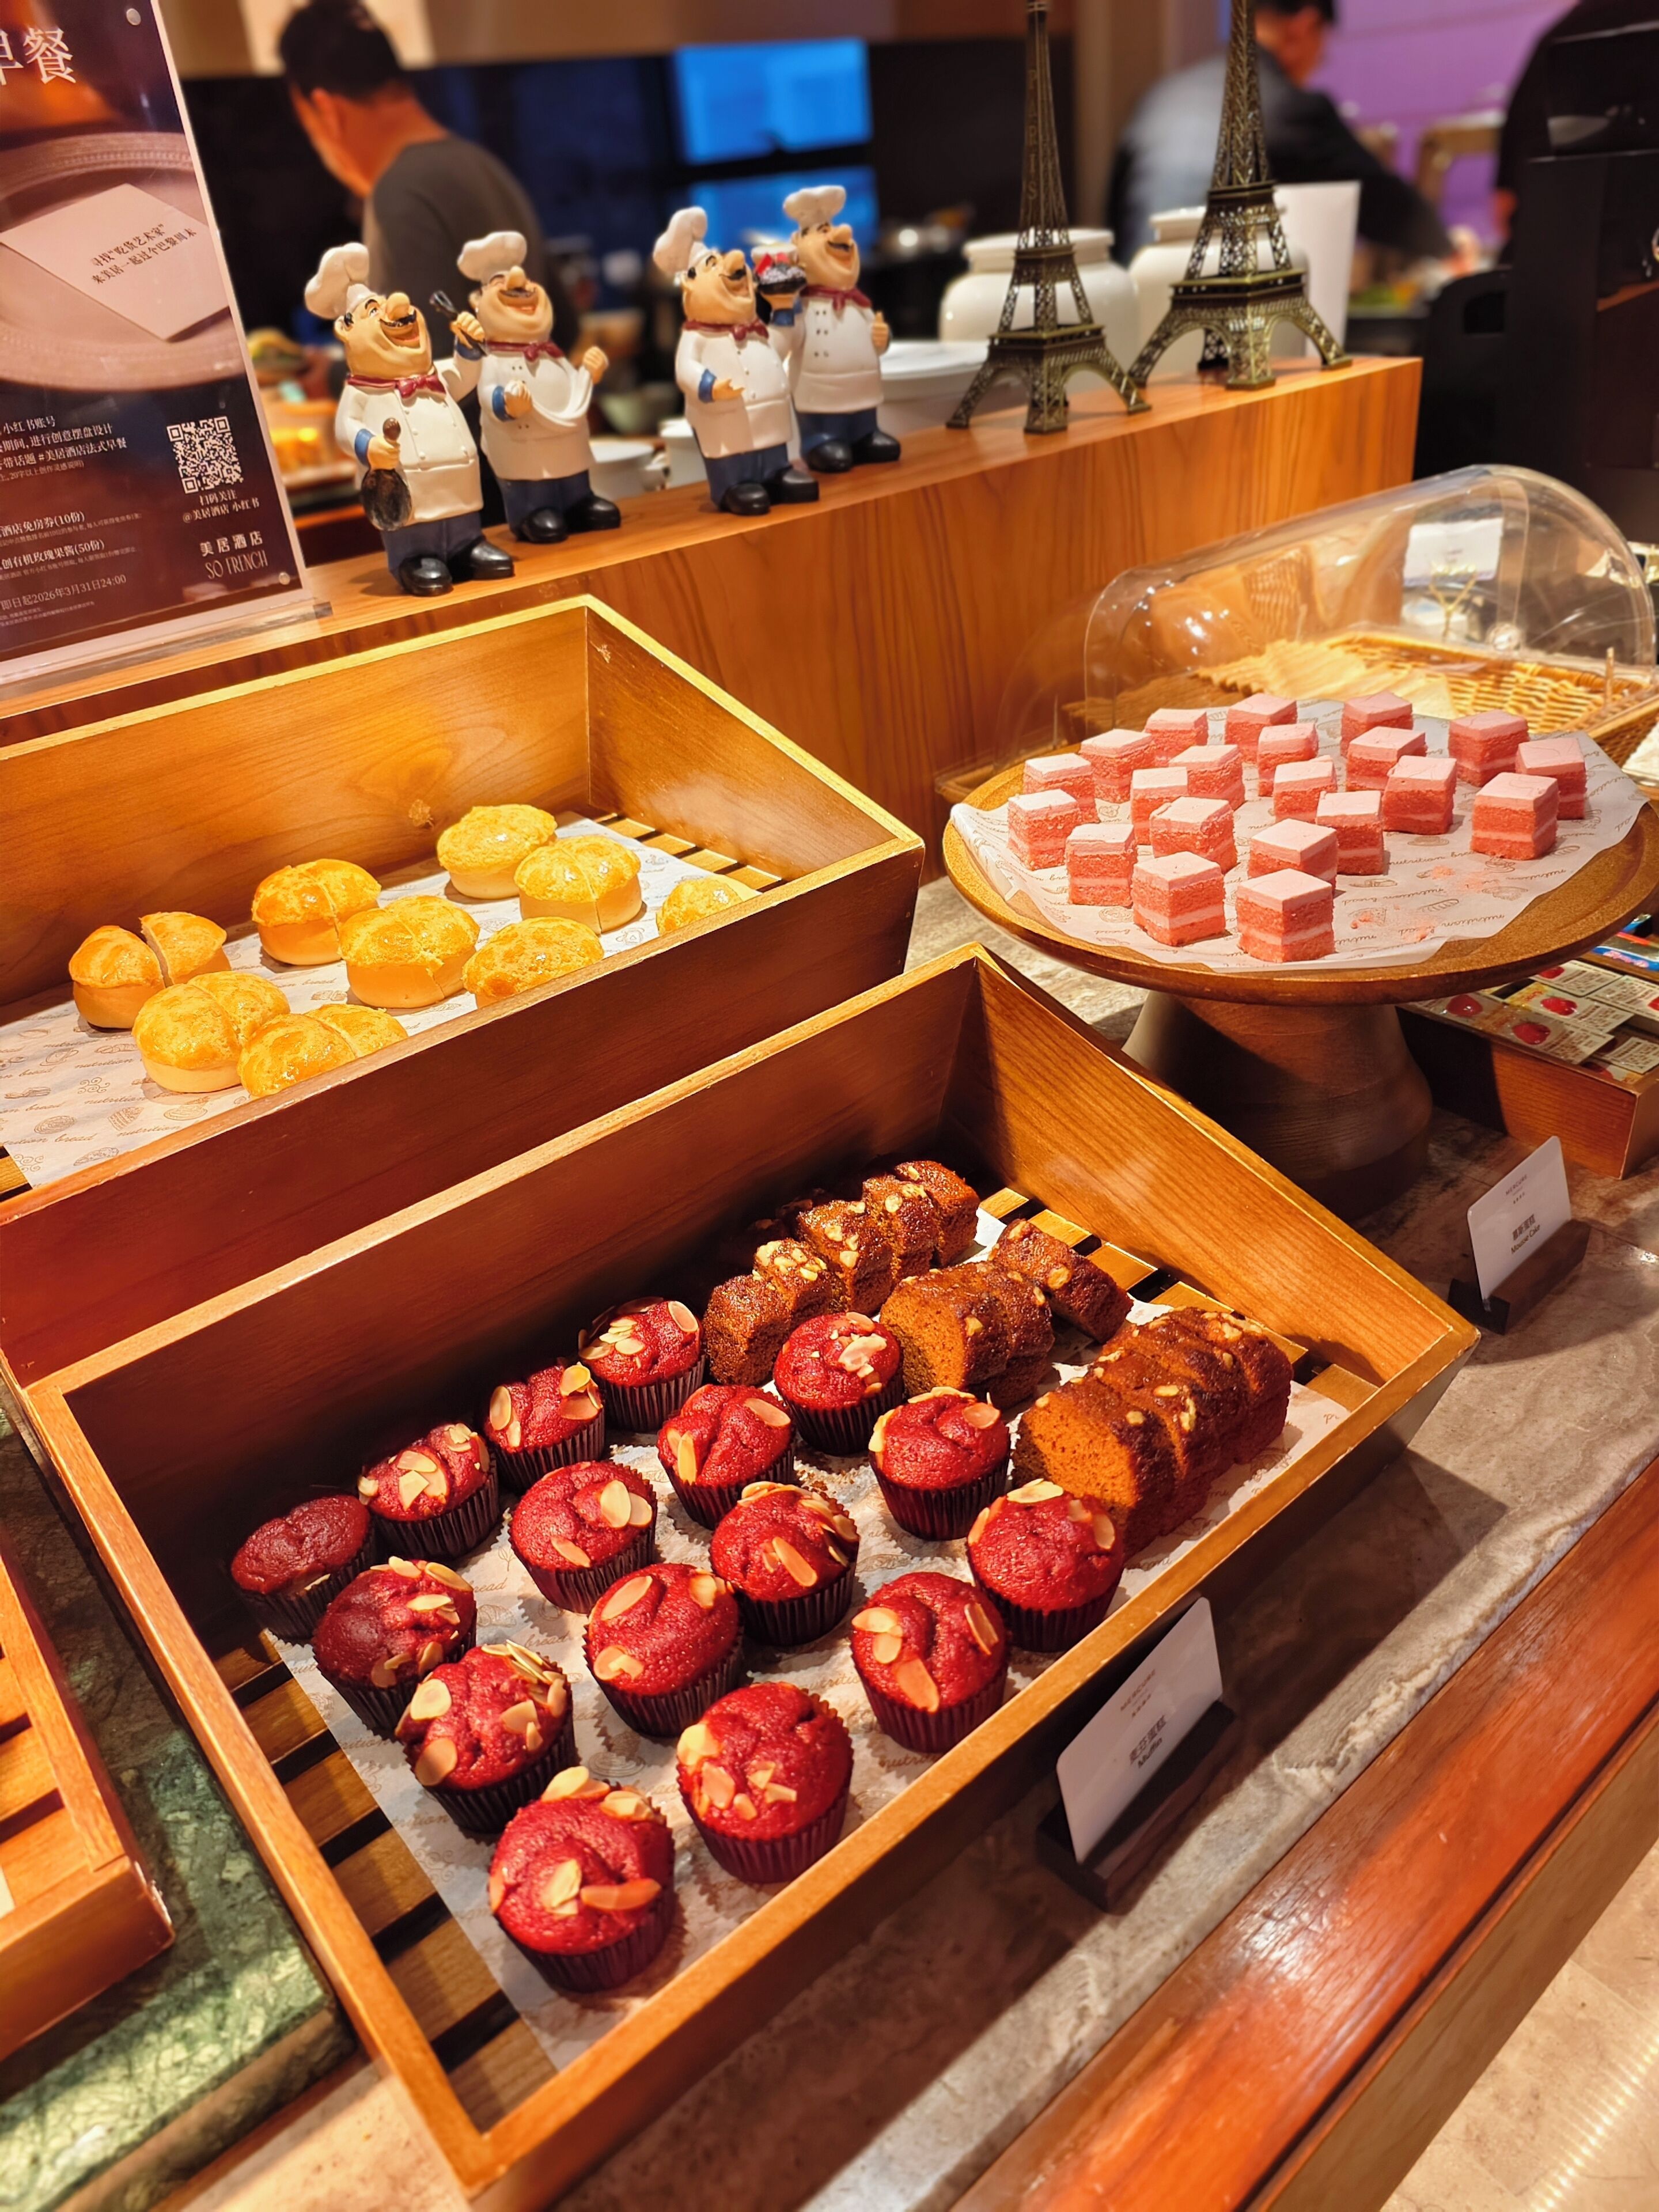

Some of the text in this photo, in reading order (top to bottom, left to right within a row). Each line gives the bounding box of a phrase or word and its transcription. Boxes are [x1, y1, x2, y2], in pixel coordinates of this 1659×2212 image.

[0, 452, 37, 470] 带话题
[199, 489, 237, 506] 扫码关注
[0, 511, 85, 538] 酒店免房券(10份)
[200, 531, 263, 558] 美居酒店
[0, 539, 105, 570] 创有机玫瑰果酱(50份)
[205, 550, 268, 579] SO FRENCH
[75, 1058, 134, 1069] nutrition
[55, 1132, 98, 1143] bread
[116, 1125, 180, 1137] nutrition
[524, 1631, 570, 1647] bread
